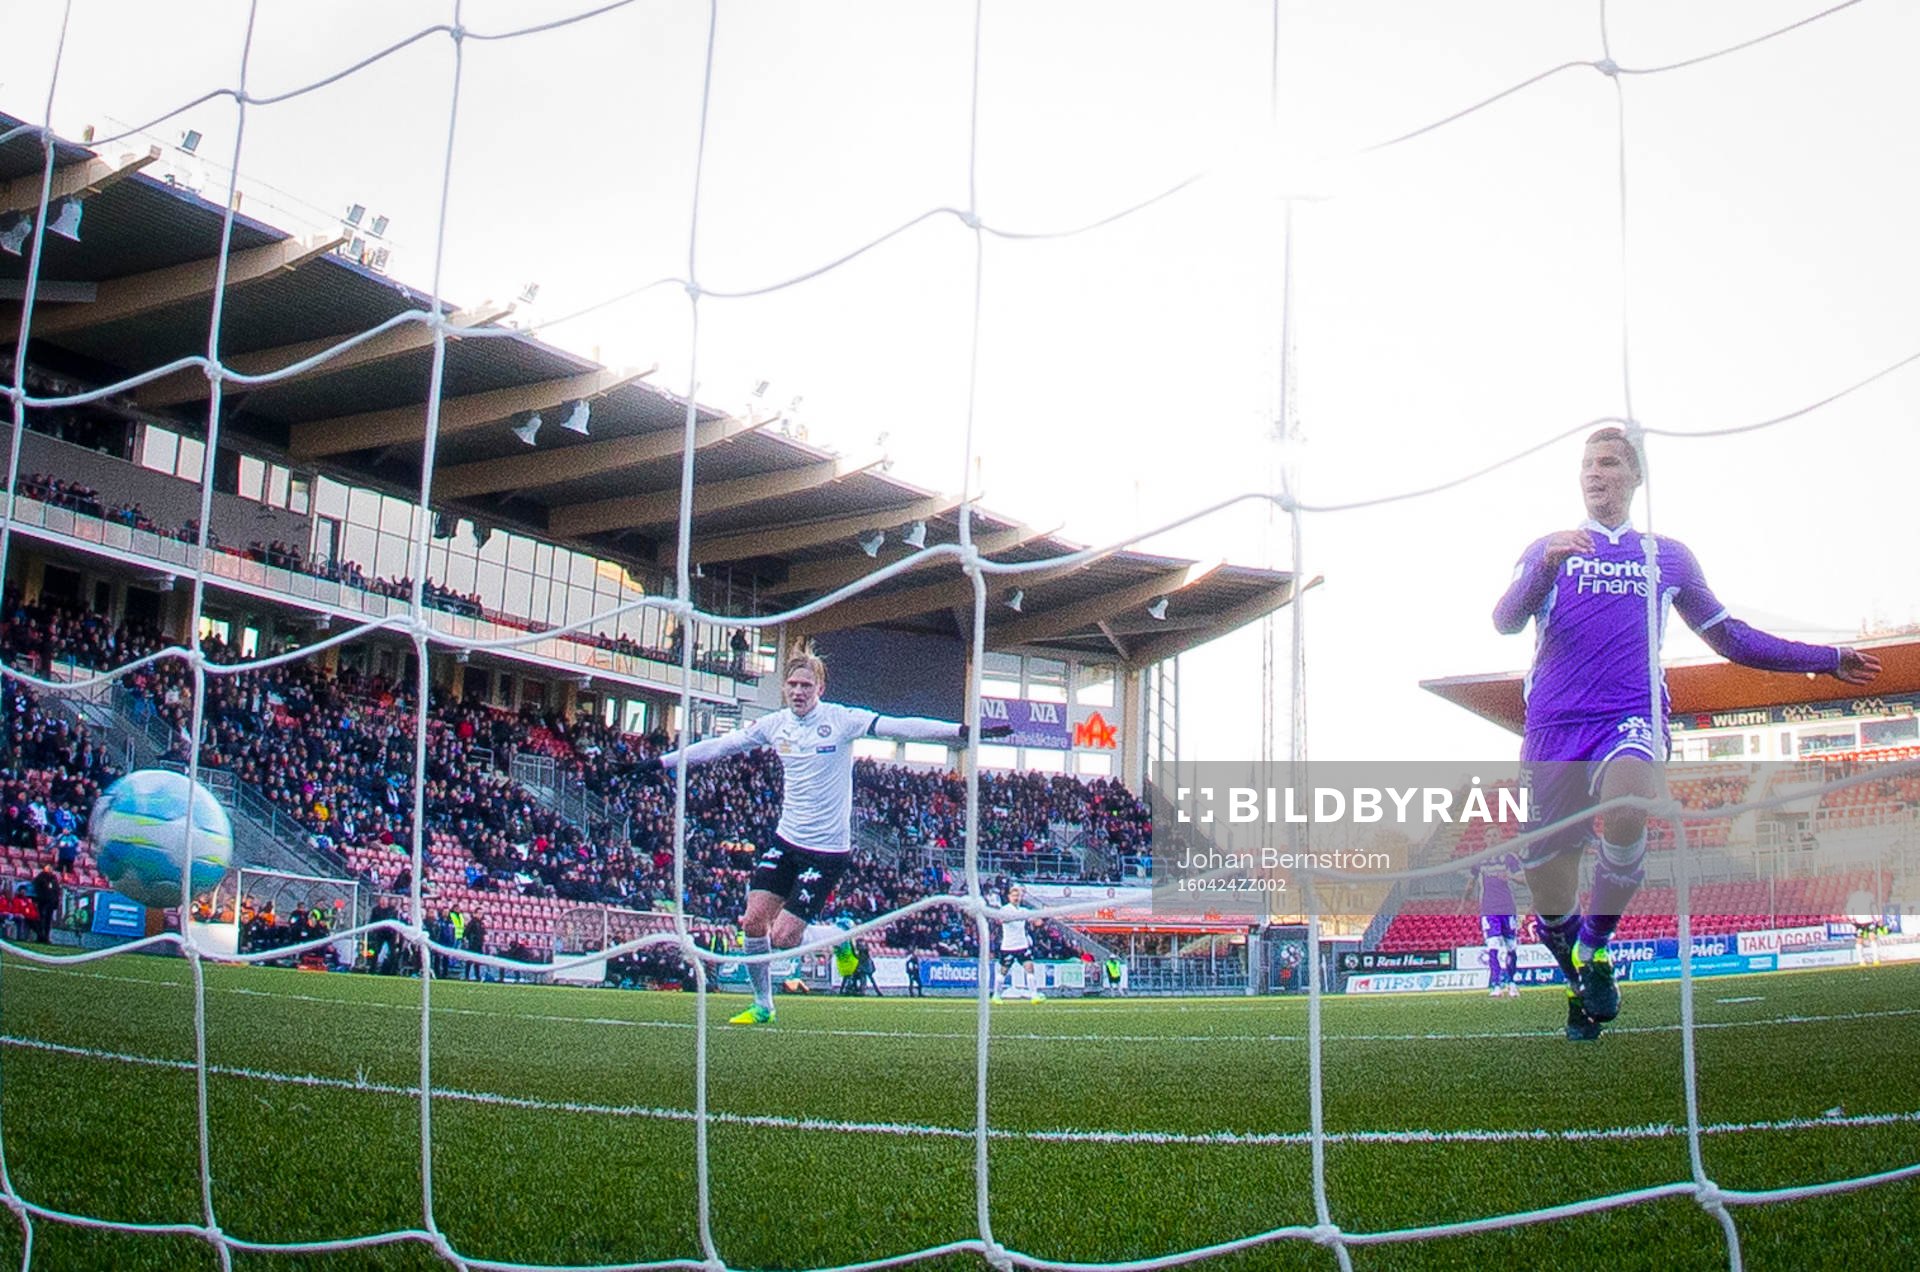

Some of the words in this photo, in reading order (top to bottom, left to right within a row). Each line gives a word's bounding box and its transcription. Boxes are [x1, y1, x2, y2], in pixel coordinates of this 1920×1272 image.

[1577, 574, 1650, 598] Finans
[981, 700, 1009, 720] NA
[1029, 702, 1060, 723] NA
[1689, 943, 1726, 957] PMG
[929, 965, 978, 981] nethouse
[1372, 976, 1415, 990] TIPS
[1435, 973, 1479, 987] ELIT
